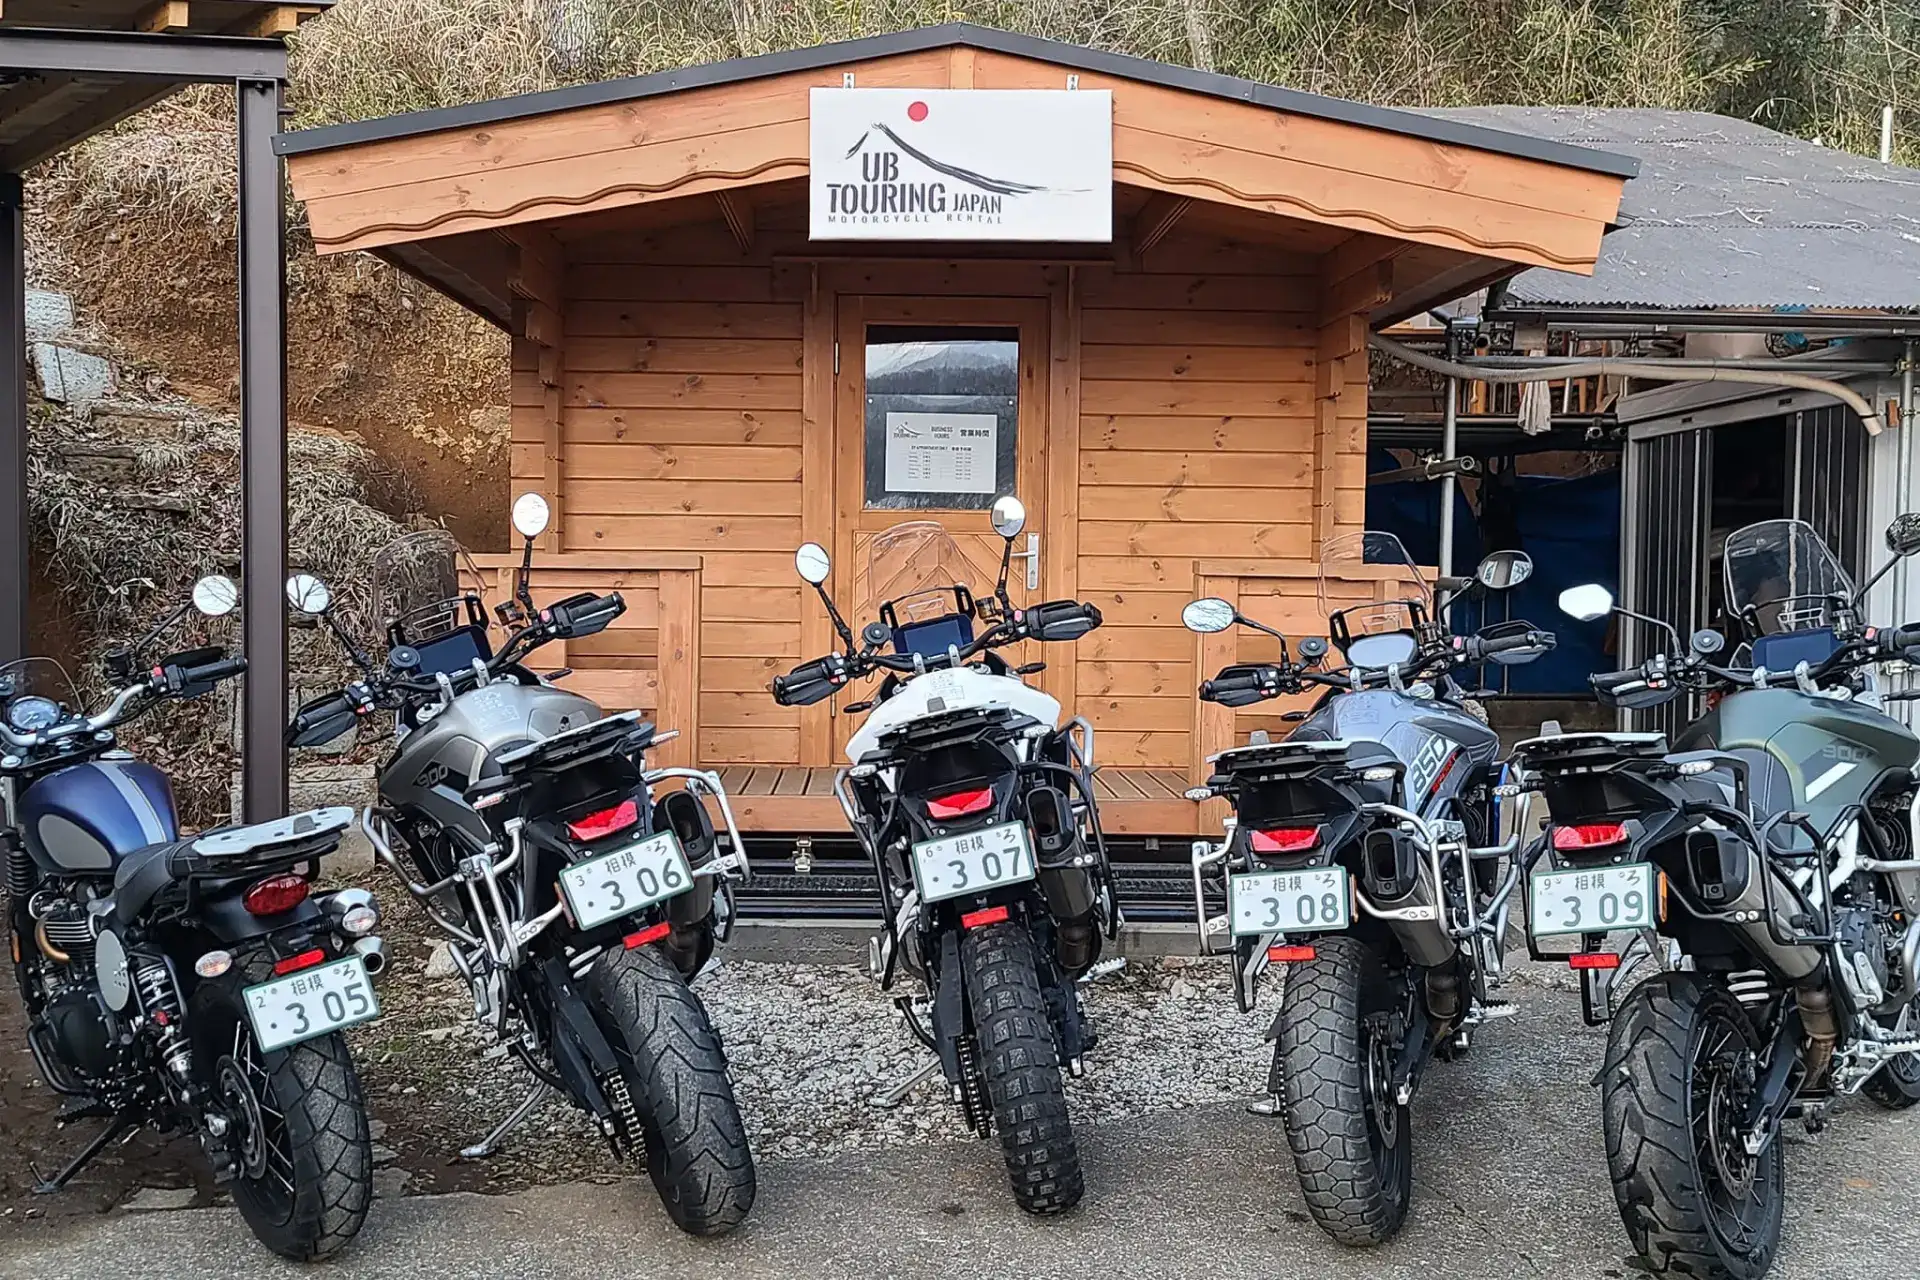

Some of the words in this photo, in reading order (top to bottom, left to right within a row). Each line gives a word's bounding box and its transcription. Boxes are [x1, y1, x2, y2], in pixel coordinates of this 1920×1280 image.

[861, 151, 900, 183] UB
[826, 183, 946, 215] TOURING
[952, 193, 1002, 214] JAPAN
[827, 214, 931, 225] MOTORCYCLE
[946, 213, 1003, 225] RENTAL
[416, 764, 448, 788] 900
[1413, 734, 1447, 794] 850
[925, 846, 934, 858] 6
[955, 835, 985, 855] 相模
[1003, 828, 1016, 844] ろ
[575, 875, 586, 887] 3
[604, 851, 637, 875] 相模
[653, 840, 668, 856] ろ
[1241, 879, 1252, 891] 12
[1272, 875, 1302, 892] 相模
[1322, 873, 1336, 888] ろ
[1543, 878, 1552, 890] 9
[1575, 873, 1605, 890] 相模
[1626, 869, 1641, 886] ろ
[255, 995, 267, 1009] 2
[290, 973, 324, 997] 相模
[342, 963, 357, 980] ろ
